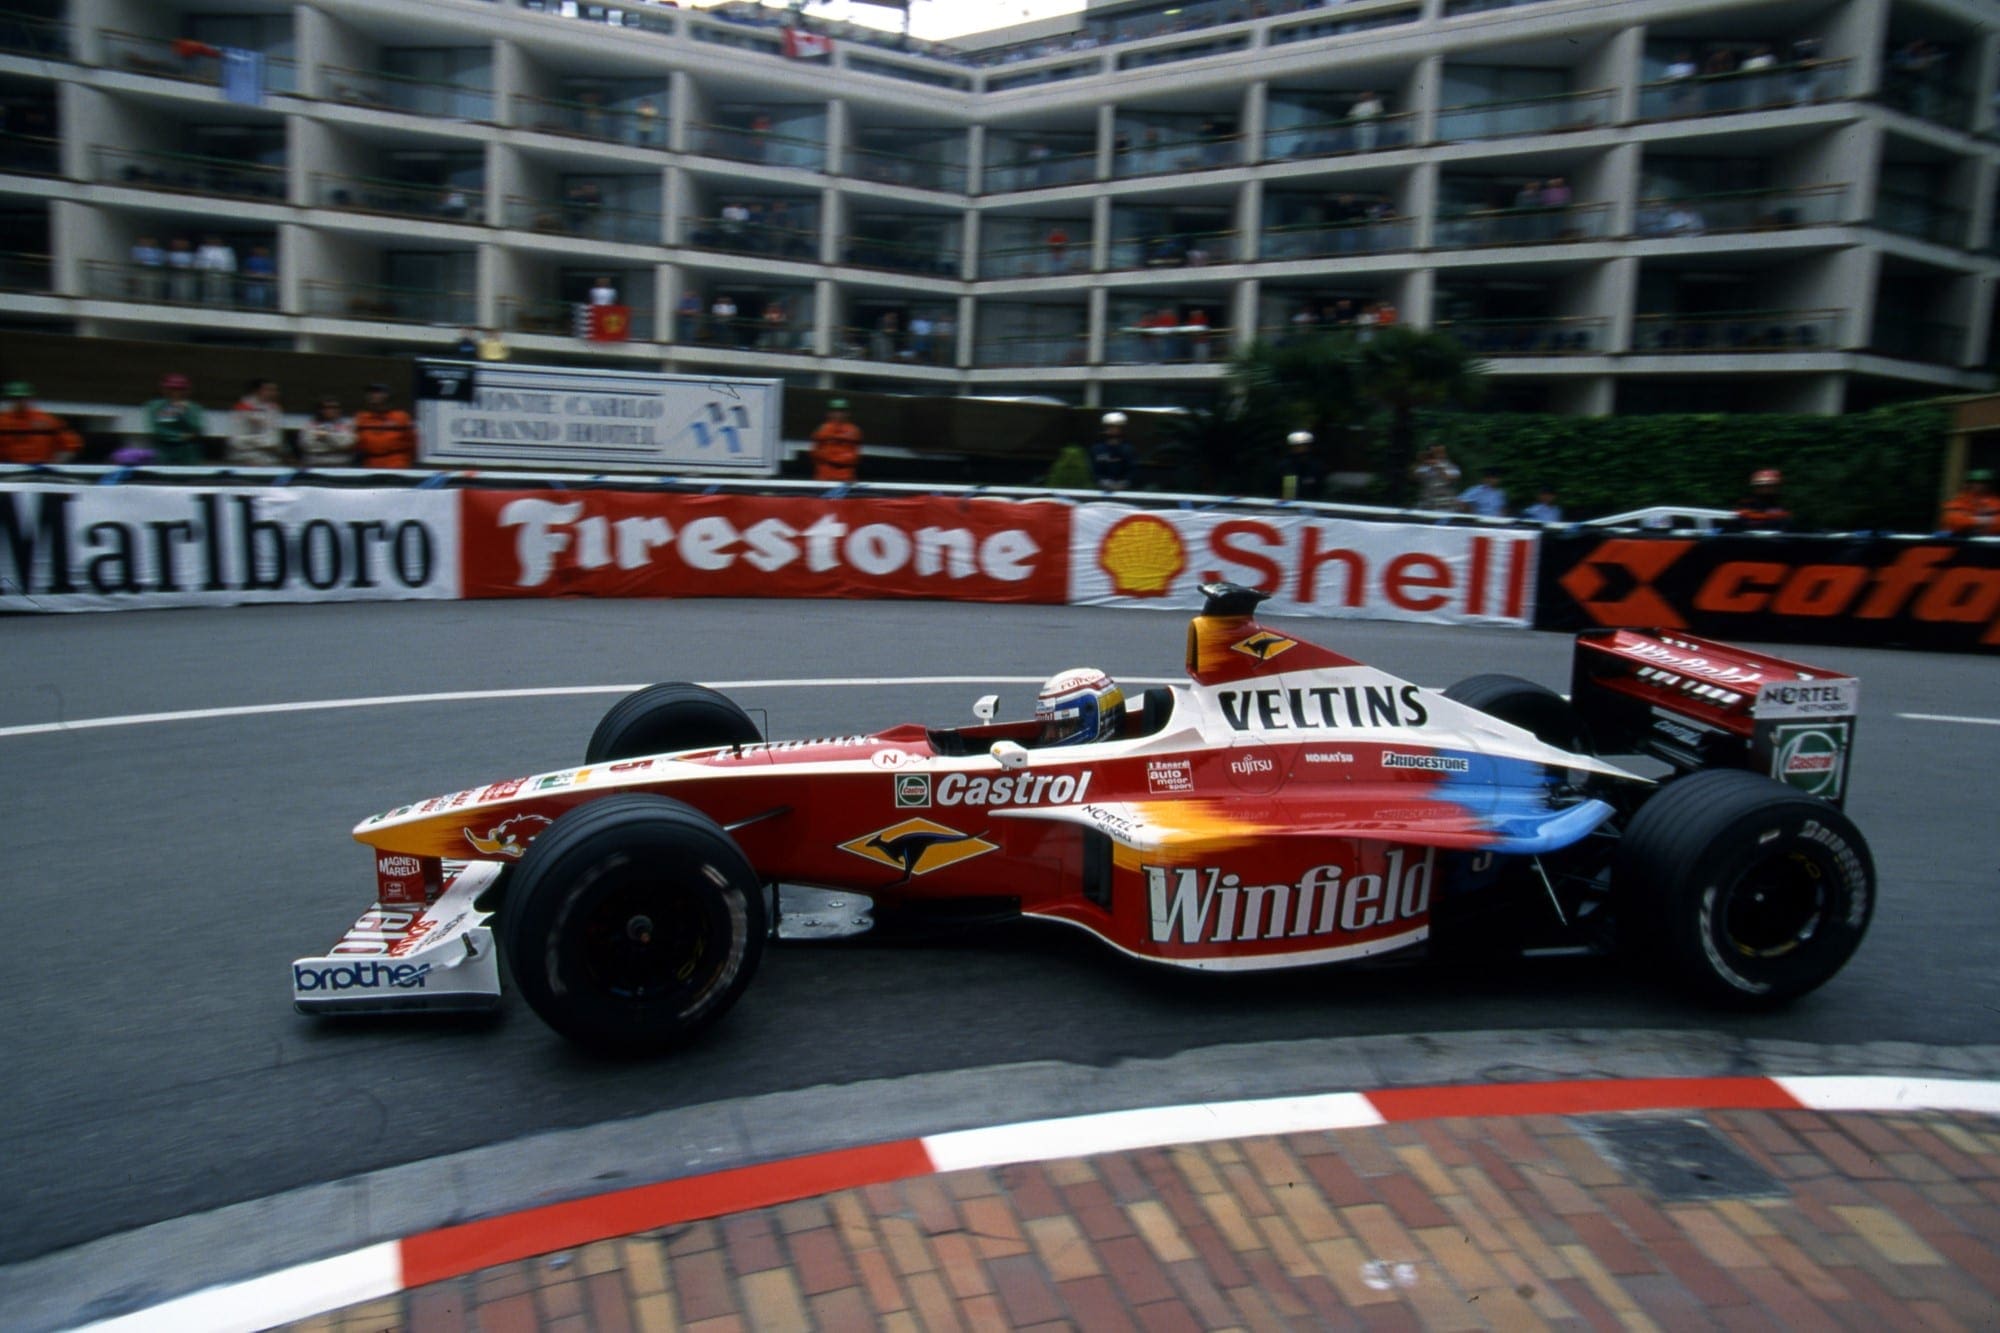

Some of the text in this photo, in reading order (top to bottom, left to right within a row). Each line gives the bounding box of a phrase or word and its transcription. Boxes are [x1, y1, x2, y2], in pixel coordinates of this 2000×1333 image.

[450, 417, 657, 446] GRAND HOTEL
[0, 491, 438, 595] Marlboro
[497, 497, 1041, 587] Firestone
[1202, 519, 1530, 619] Shell
[1217, 685, 1428, 731] VELTINS
[1763, 686, 1841, 705] NORTEL
[1150, 770, 1181, 780] auto
[1231, 754, 1273, 776] FUJITSU
[1382, 751, 1468, 772] BRIDGESTONE
[1788, 754, 1833, 770] Castrol
[936, 770, 1092, 806] Castrol
[1082, 804, 1133, 832] NORTEL
[379, 856, 421, 872] MAGNETI
[379, 861, 421, 877] MARELLI
[1141, 845, 1438, 945] Winfield
[294, 961, 432, 991] brother
